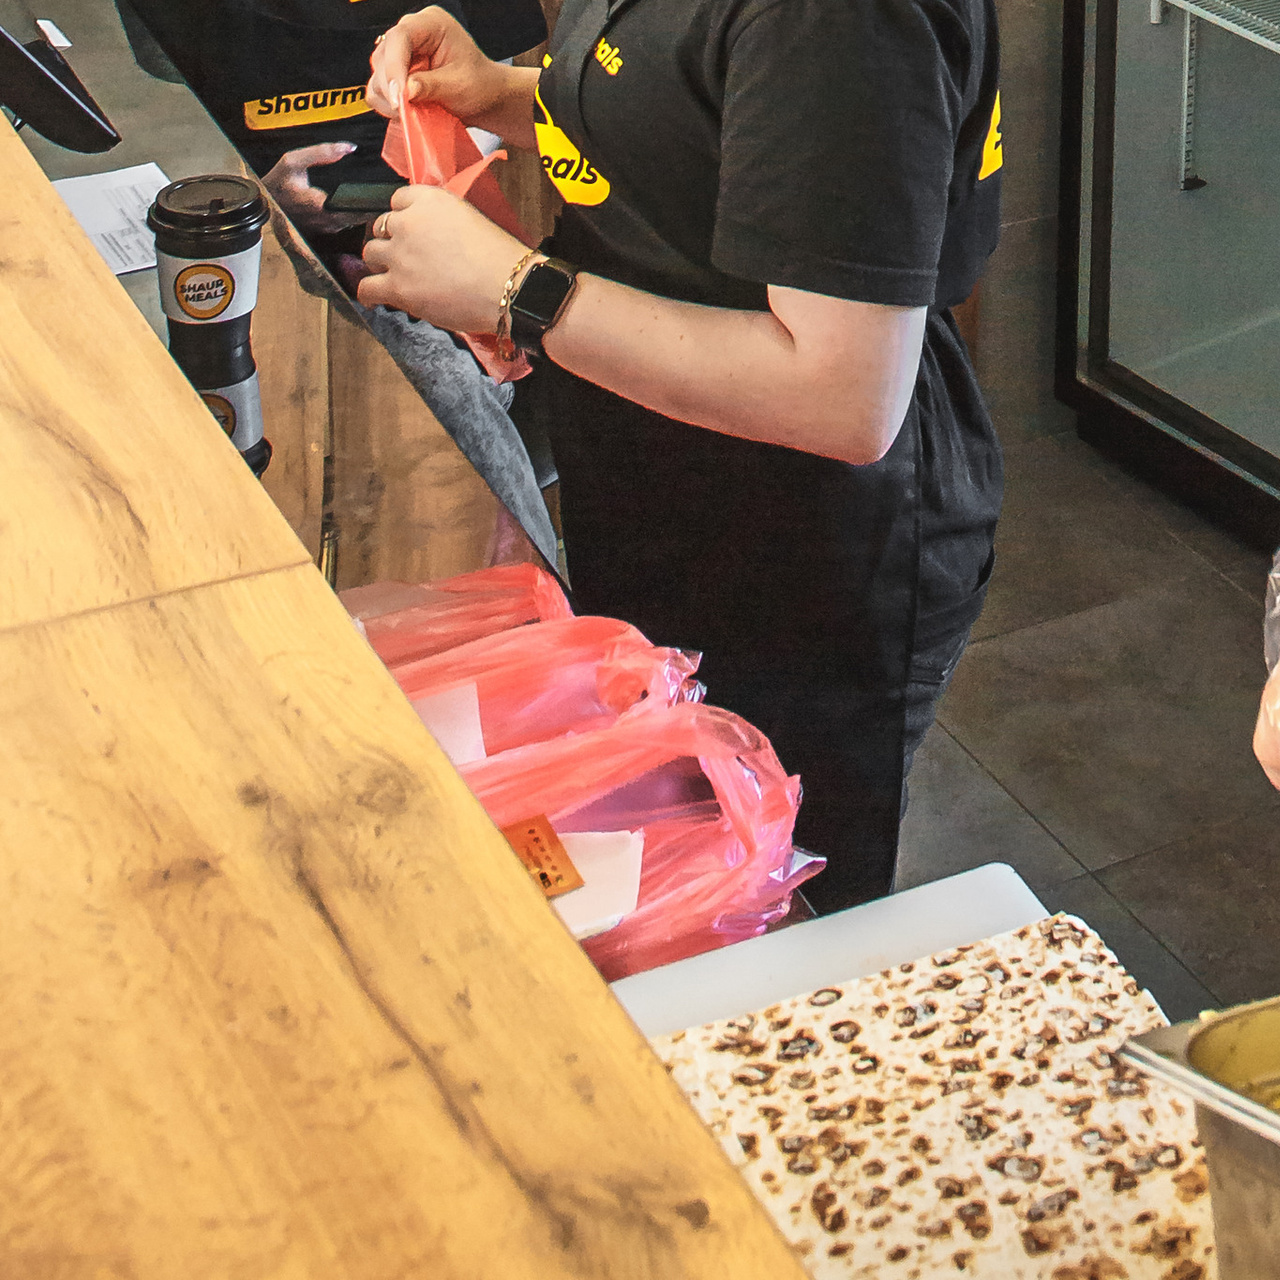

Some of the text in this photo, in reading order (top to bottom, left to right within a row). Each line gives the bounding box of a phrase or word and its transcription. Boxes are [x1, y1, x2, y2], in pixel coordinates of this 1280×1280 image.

[256, 85, 368, 116] Shaurm
[179, 279, 224, 294] SHAUR
[185, 286, 228, 303] MEALS
